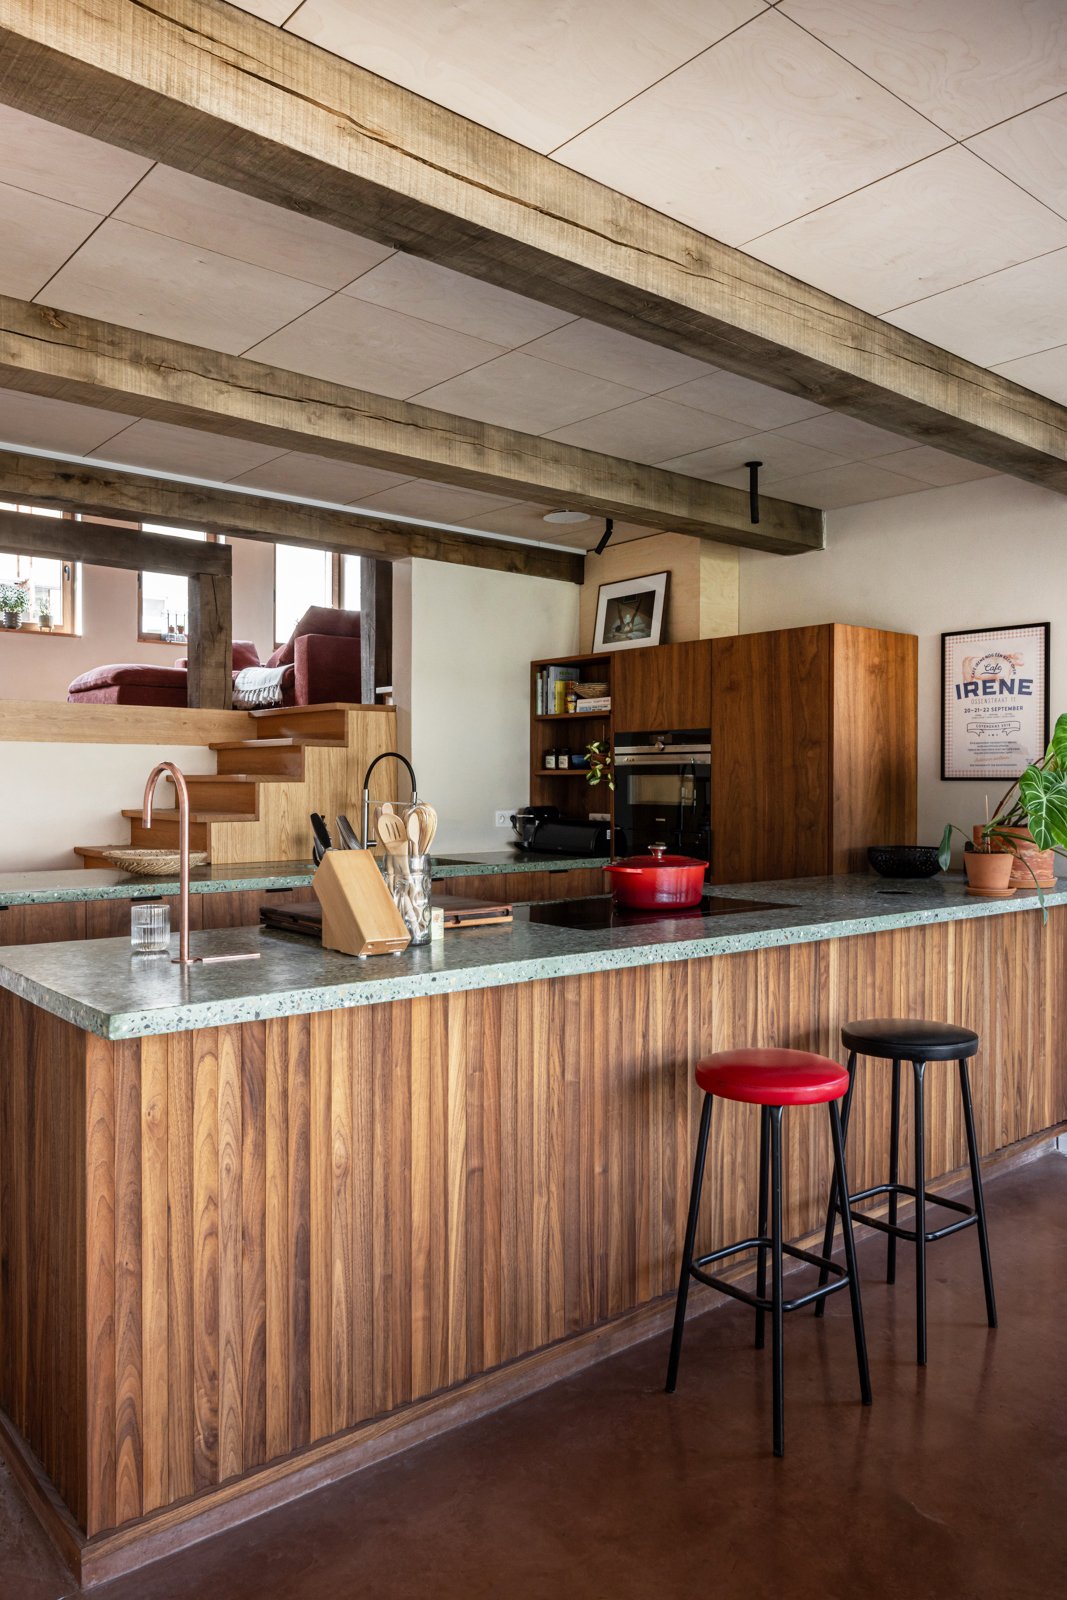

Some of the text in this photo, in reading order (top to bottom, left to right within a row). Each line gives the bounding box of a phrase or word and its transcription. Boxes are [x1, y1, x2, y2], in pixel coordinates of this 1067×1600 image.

[955, 678, 1034, 700] IRENE
[971, 697, 1008, 705] OSSENSTRAAT
[991, 705, 1024, 713] SEPTEMBER
